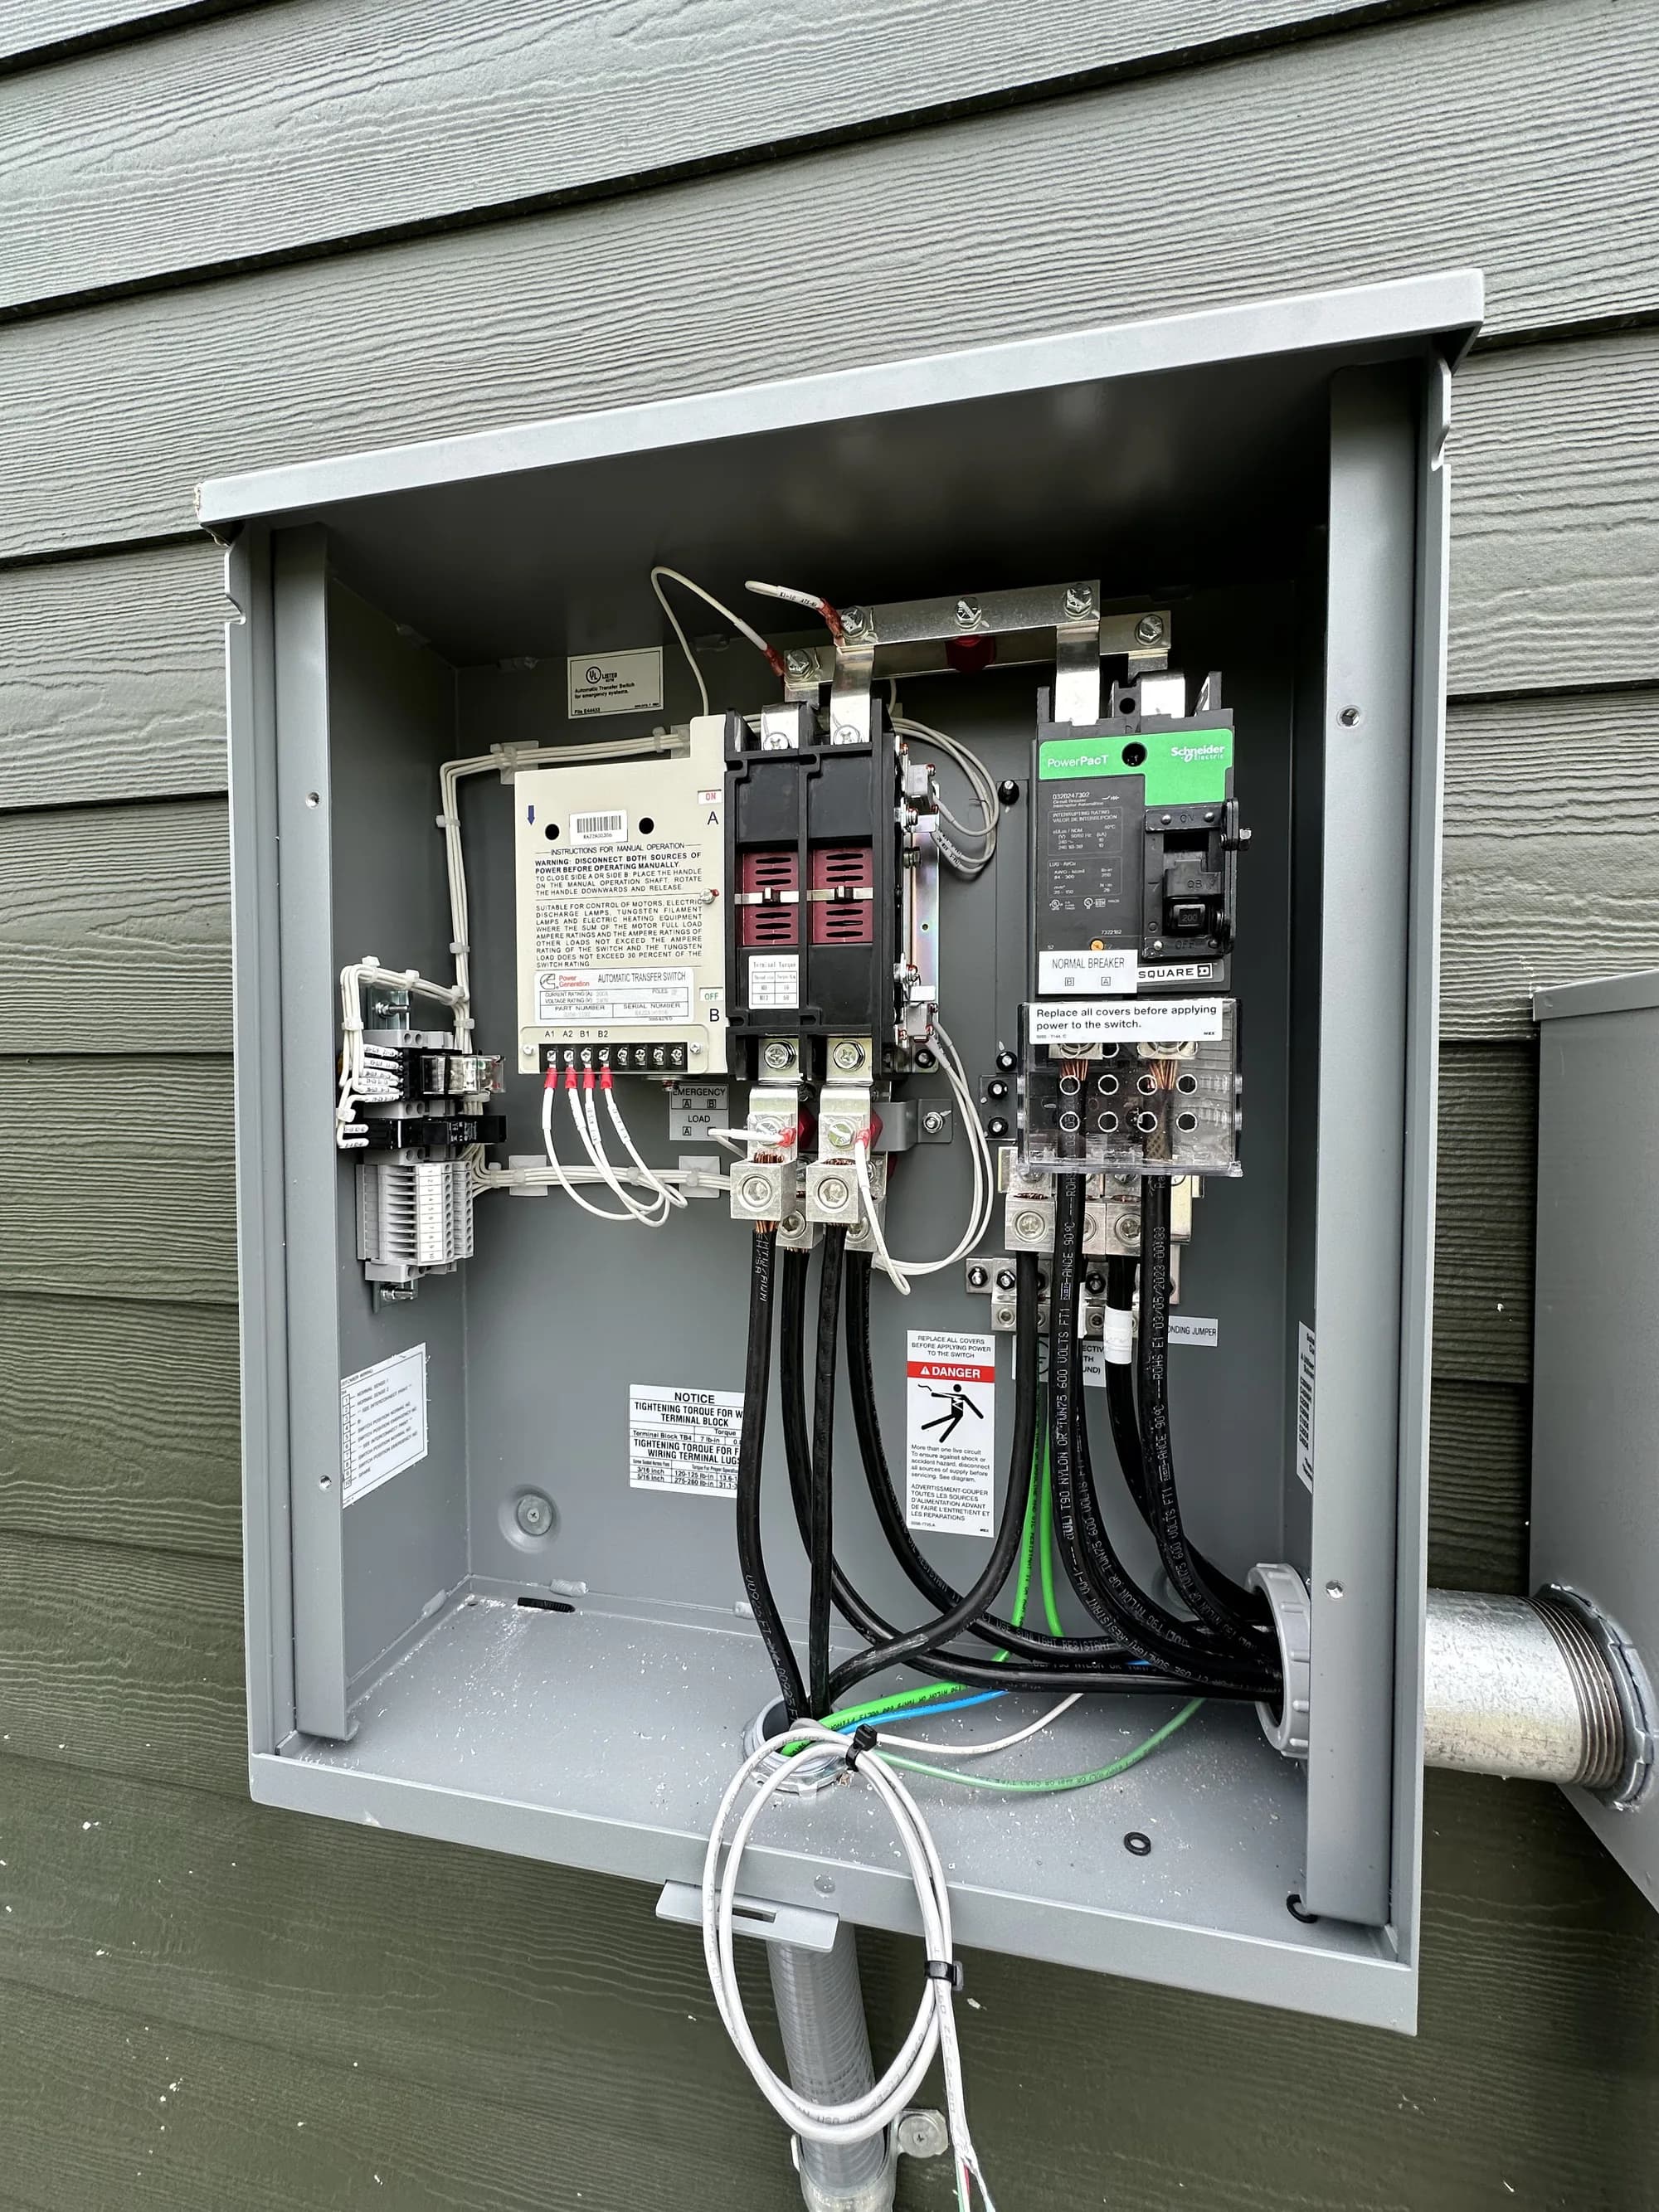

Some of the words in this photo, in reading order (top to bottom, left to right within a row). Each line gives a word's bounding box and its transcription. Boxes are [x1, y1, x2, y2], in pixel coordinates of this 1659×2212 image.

[1171, 746, 1224, 756] Schneider
[1048, 755, 1108, 767] PowerPacT
[707, 811, 718, 825] A
[552, 847, 597, 856] INSTRUCTIONS
[647, 843, 685, 851] OPERATION
[575, 856, 622, 864] DISCONNECT
[650, 853, 687, 861] SOURCES
[594, 863, 637, 872] OPERATING
[1053, 958, 1086, 970] NORMAL
[1088, 957, 1125, 969] BREAKER
[598, 973, 630, 984] AUTOMATIC
[631, 972, 661, 982] TRANSFER
[664, 971, 686, 981] SWITCH
[1138, 968, 1194, 979] SQUARE
[710, 1009, 720, 1022] B
[1037, 1009, 1078, 1018] Replace
[1081, 1008, 1092, 1016] all
[1135, 1006, 1168, 1015] before
[1171, 1005, 1217, 1015] applying
[1037, 1021, 1068, 1031] power
[1072, 1021, 1082, 1029] to
[1085, 1020, 1101, 1028] the
[1104, 1019, 1141, 1028] switch.
[673, 1087, 726, 1096] EMERGENCY
[1152, 1261, 1165, 1329] 03/05/2023
[1058, 1308, 1070, 1326] FT1
[1168, 1325, 1190, 1334] ONDING
[1192, 1328, 1216, 1336] JUMPER
[1057, 1330, 1069, 1364] VOLTS
[932, 1367, 980, 1378] DANGER
[1057, 1369, 1068, 1388] 600
[674, 1393, 715, 1403] NOTICE
[635, 1402, 680, 1413] TIGHTENING
[684, 1406, 714, 1416] TORQUE
[1056, 1395, 1068, 1429] TWN75
[661, 1414, 700, 1424] TERMINAL
[703, 1417, 728, 1427] BLOCK
[634, 1439, 679, 1450] TIGHTENING
[683, 1443, 713, 1453] TORQUE
[717, 1446, 732, 1455] FOR
[648, 1449, 677, 1459] WIRING
[680, 1452, 718, 1463] TERMINAL
[1058, 1451, 1069, 1485] NYLON
[1060, 1490, 1071, 1510] T90
[1162, 1487, 1173, 1506] FT1
[1166, 1509, 1179, 1539] VOLTS
